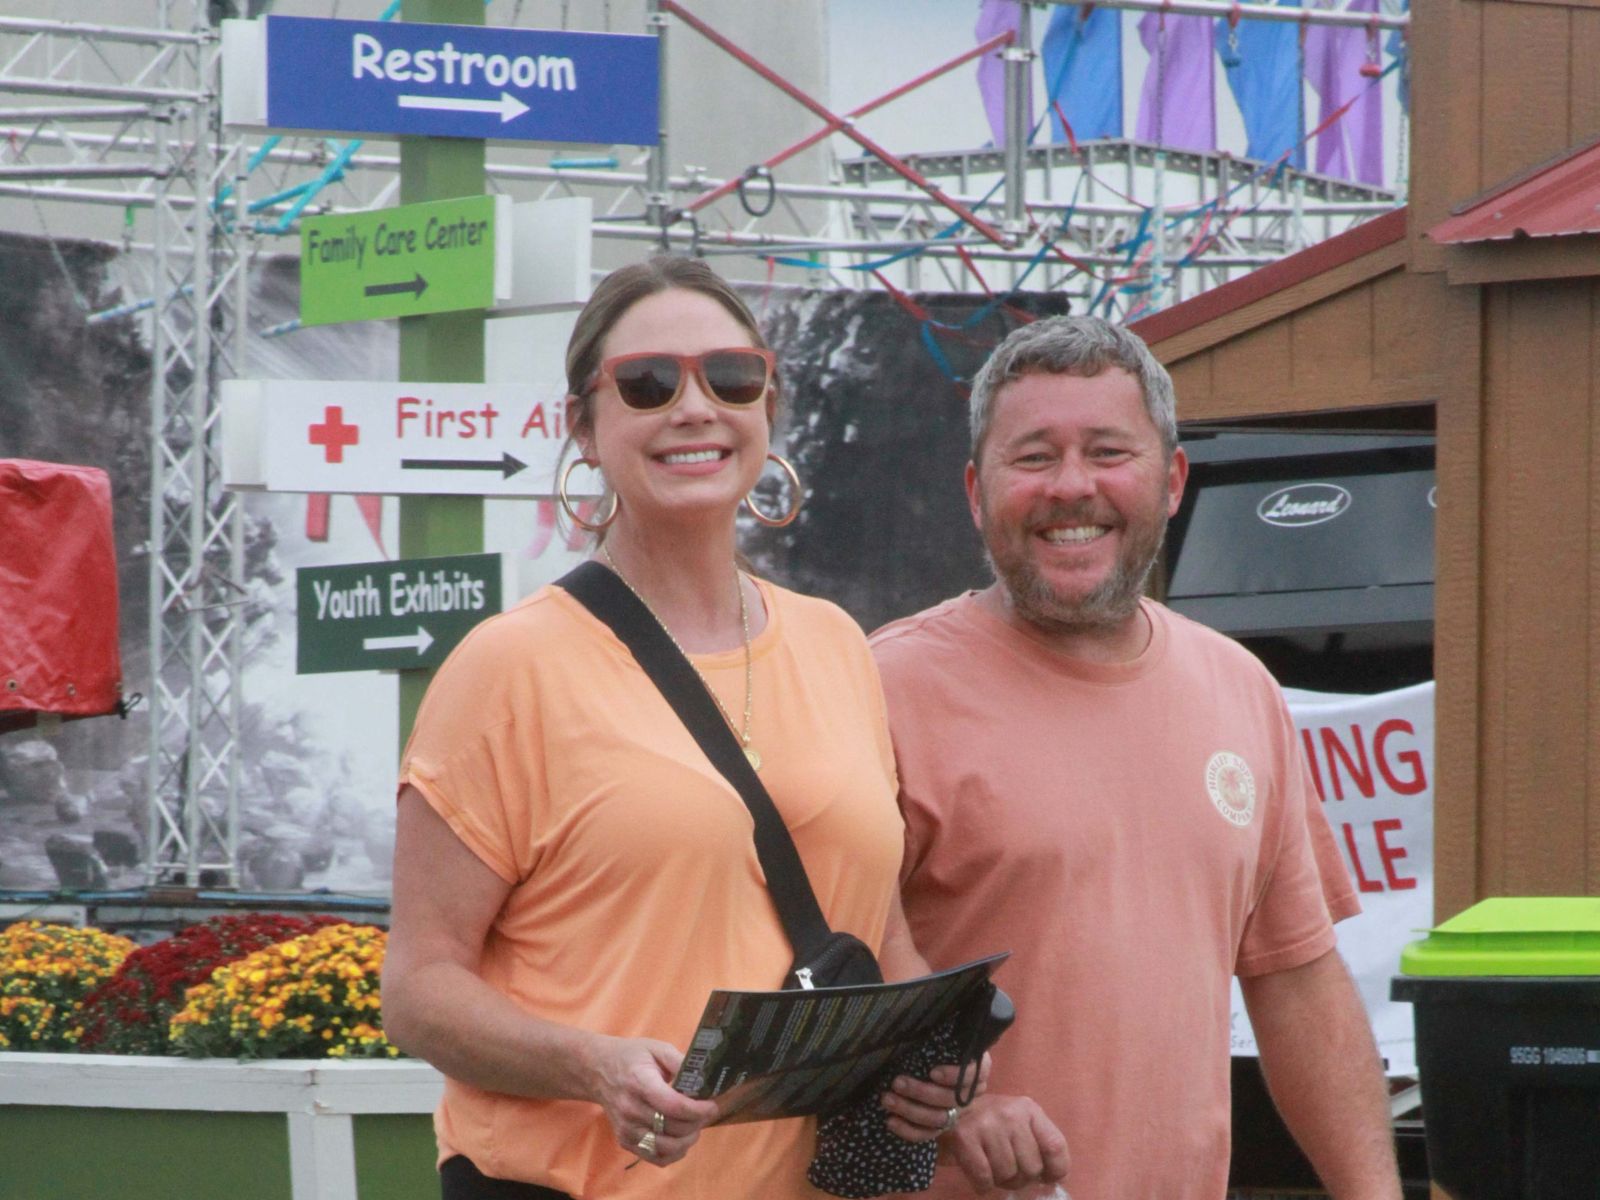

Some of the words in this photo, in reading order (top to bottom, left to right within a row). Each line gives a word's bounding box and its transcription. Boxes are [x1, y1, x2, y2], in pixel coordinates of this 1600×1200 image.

[352, 33, 577, 91] Restroom
[308, 225, 367, 270] Family
[374, 222, 417, 256] Care
[425, 216, 487, 250] Center
[396, 396, 499, 439] First
[520, 401, 562, 439] Ai
[313, 574, 381, 620] Youth
[390, 570, 485, 616] Exhibits
[1301, 718, 1428, 802] ING
[1341, 818, 1418, 893] LE
